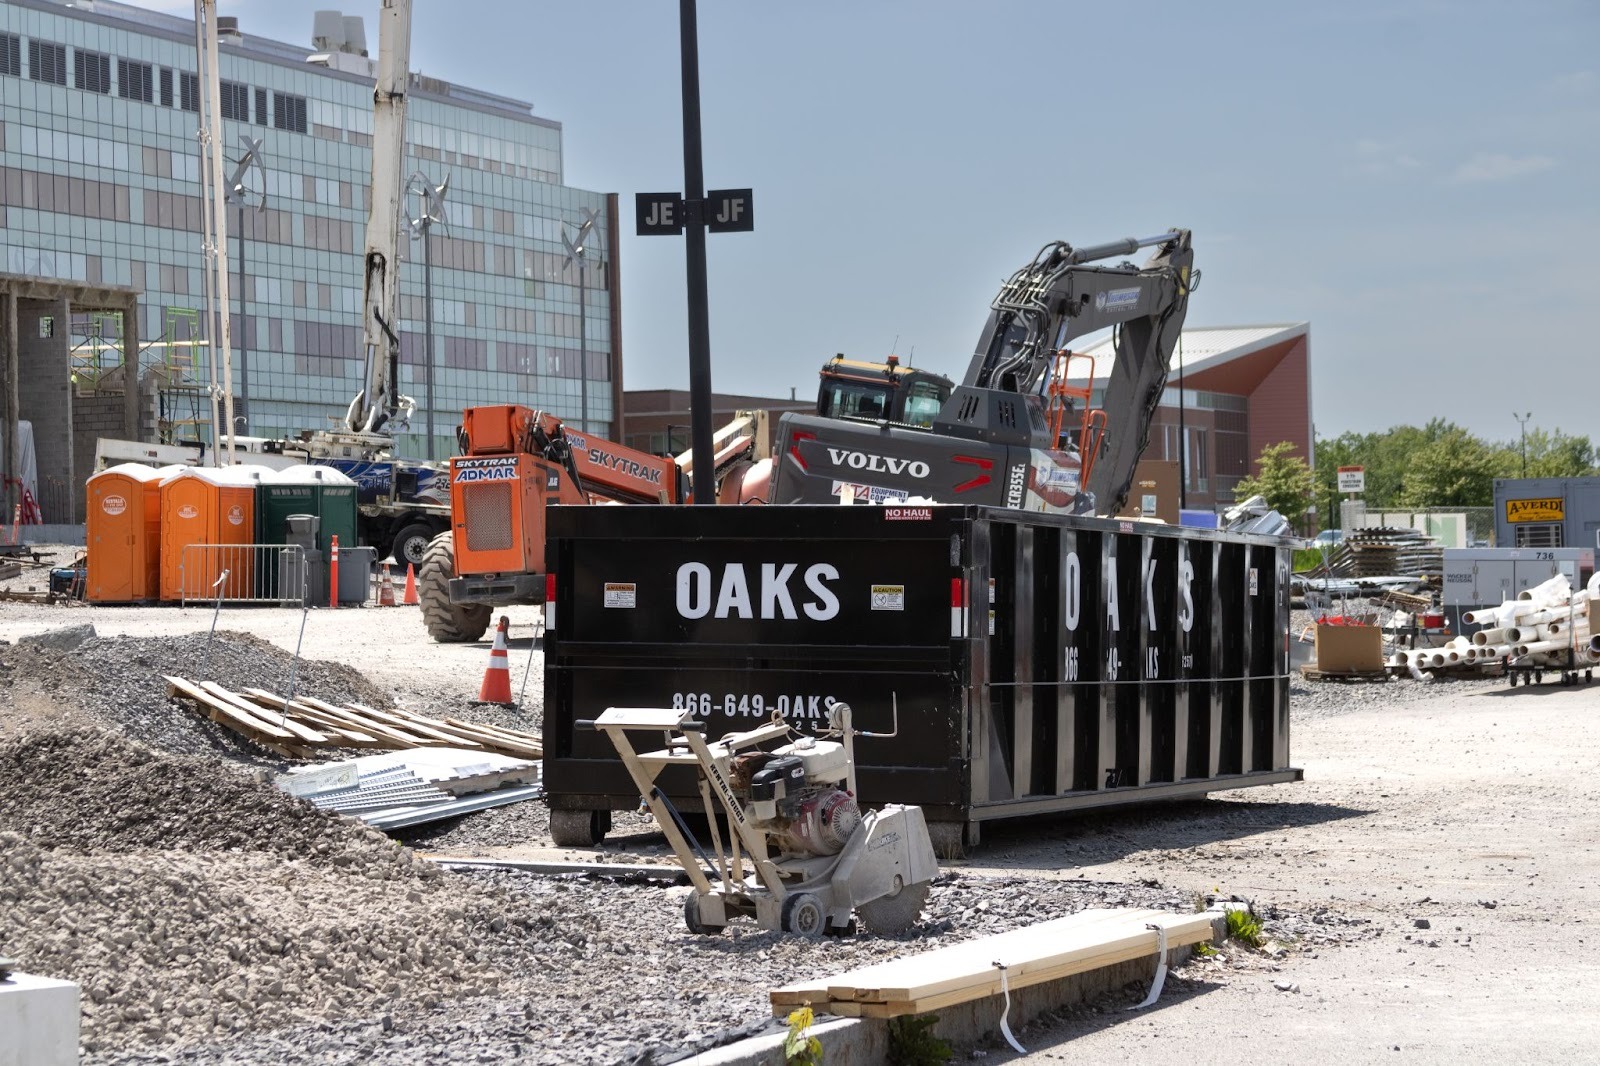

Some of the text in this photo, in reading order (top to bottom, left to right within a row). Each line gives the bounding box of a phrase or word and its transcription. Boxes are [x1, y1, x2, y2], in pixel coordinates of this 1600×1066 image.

[645, 202, 673, 225] JE
[717, 198, 744, 223] JF
[456, 457, 517, 468] SKYTRAK
[588, 448, 662, 485] SKYTRAK
[827, 448, 930, 478] VOLVO
[455, 466, 518, 482] ADMAR
[548, 477, 558, 487] JLG
[871, 487, 907, 499] EQUIPMENT
[885, 509, 931, 517] NO HAUL
[1510, 500, 1563, 515] A-VERDI
[1536, 552, 1554, 560] 736
[676, 561, 840, 621] OAKS
[672, 692, 837, 719] 866-649-OAKS
